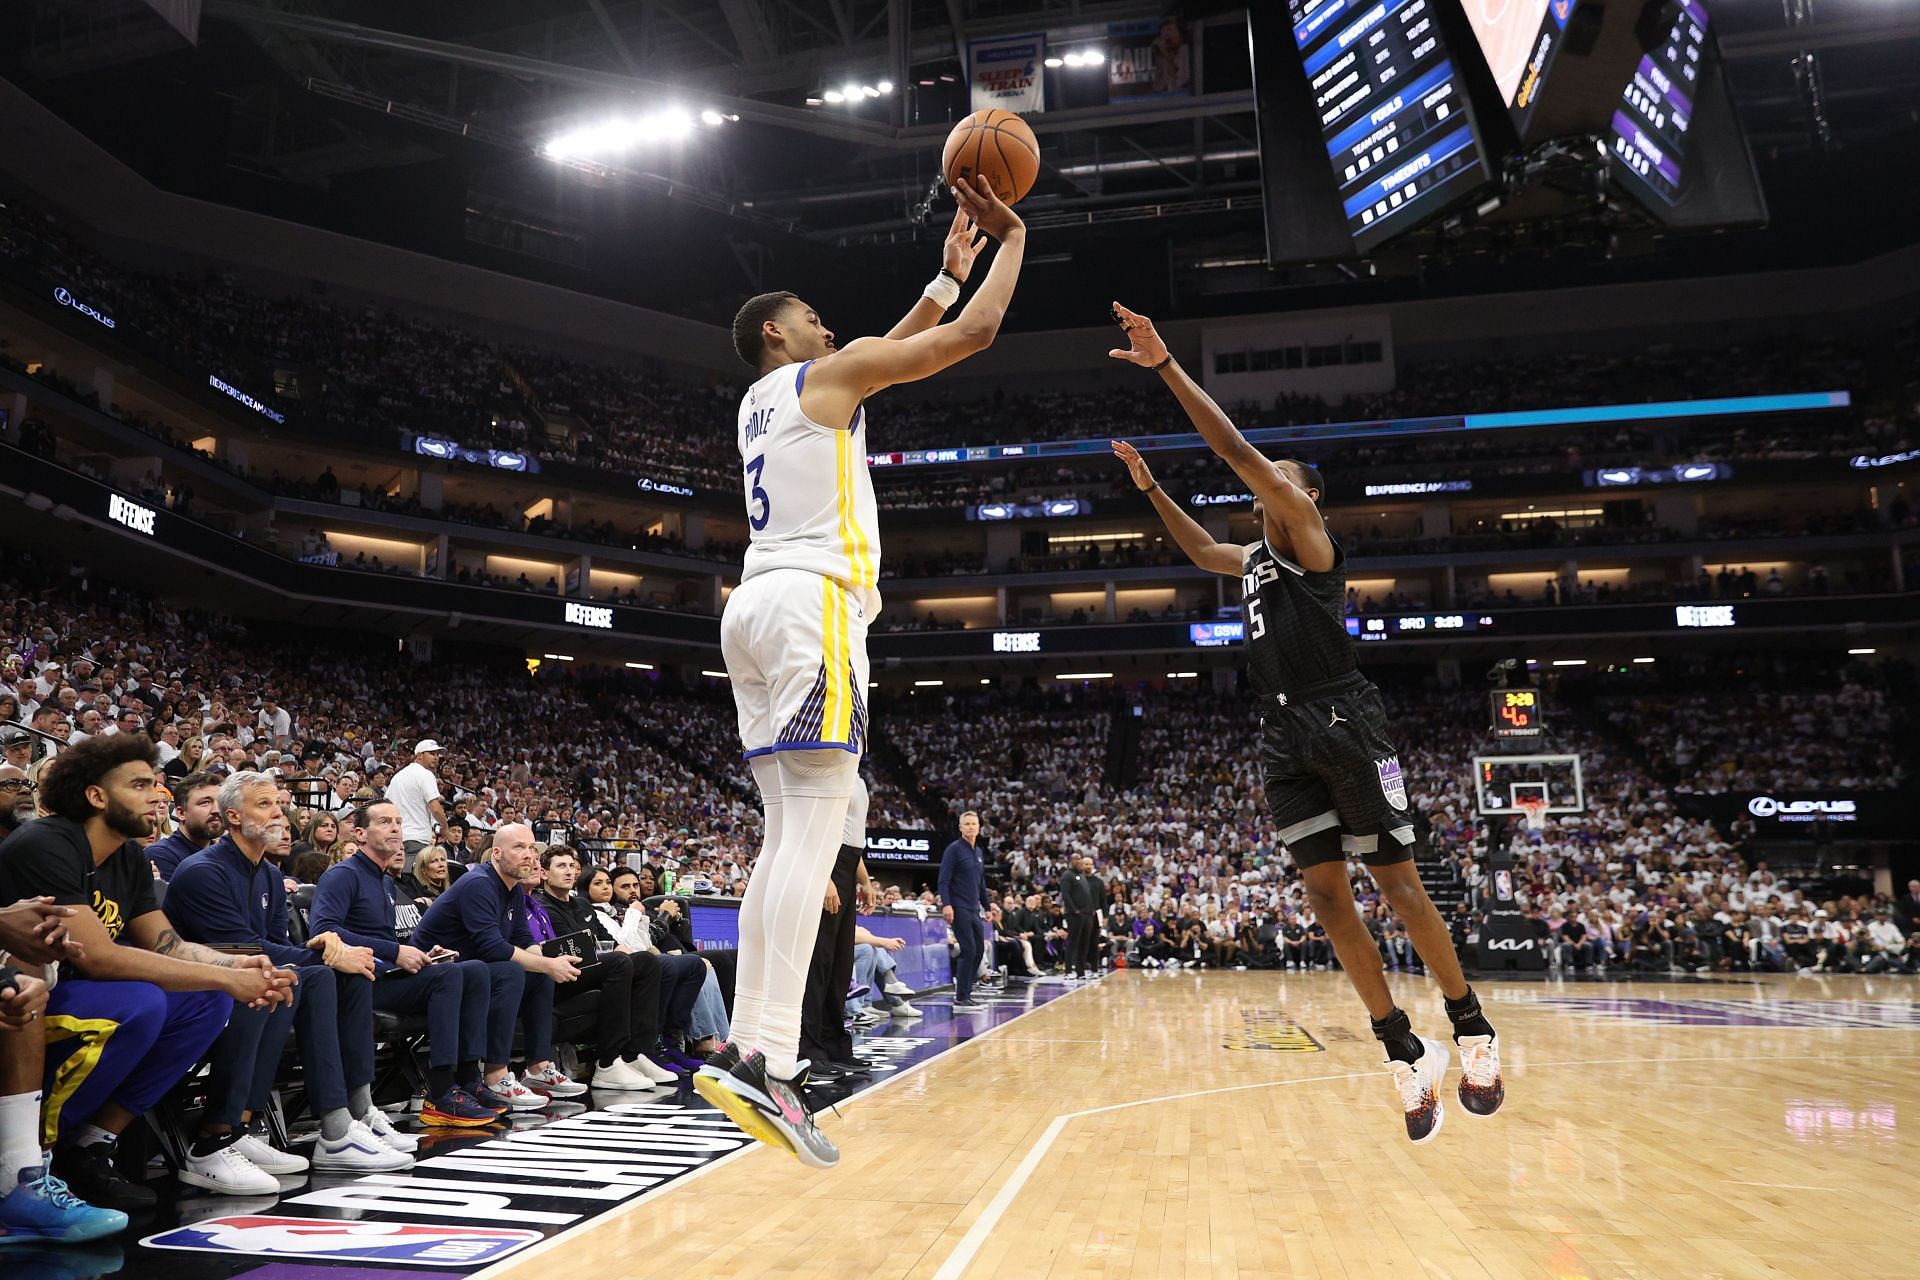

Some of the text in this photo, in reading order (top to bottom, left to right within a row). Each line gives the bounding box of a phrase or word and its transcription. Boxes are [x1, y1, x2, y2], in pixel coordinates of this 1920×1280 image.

[1370, 95, 1404, 126] FOULS
[1351, 120, 1397, 157] TEAM FOULS
[1380, 152, 1431, 191] TIMEOUTS
[72, 298, 115, 329] LEXUS
[745, 407, 775, 449] POOLE
[653, 482, 694, 497] LEXUS
[746, 453, 770, 532] 3
[109, 493, 156, 536] DEFENSE
[565, 602, 613, 629] DEFENSE
[1248, 598, 1266, 640] 5
[1399, 616, 1426, 630] 3RD
[1676, 605, 1736, 627] DEFENSE
[993, 632, 1041, 652] DEFENSE
[1777, 800, 1857, 813] LEXUS
[867, 837, 930, 851] LEXUS
[1487, 938, 1534, 951] KIA
